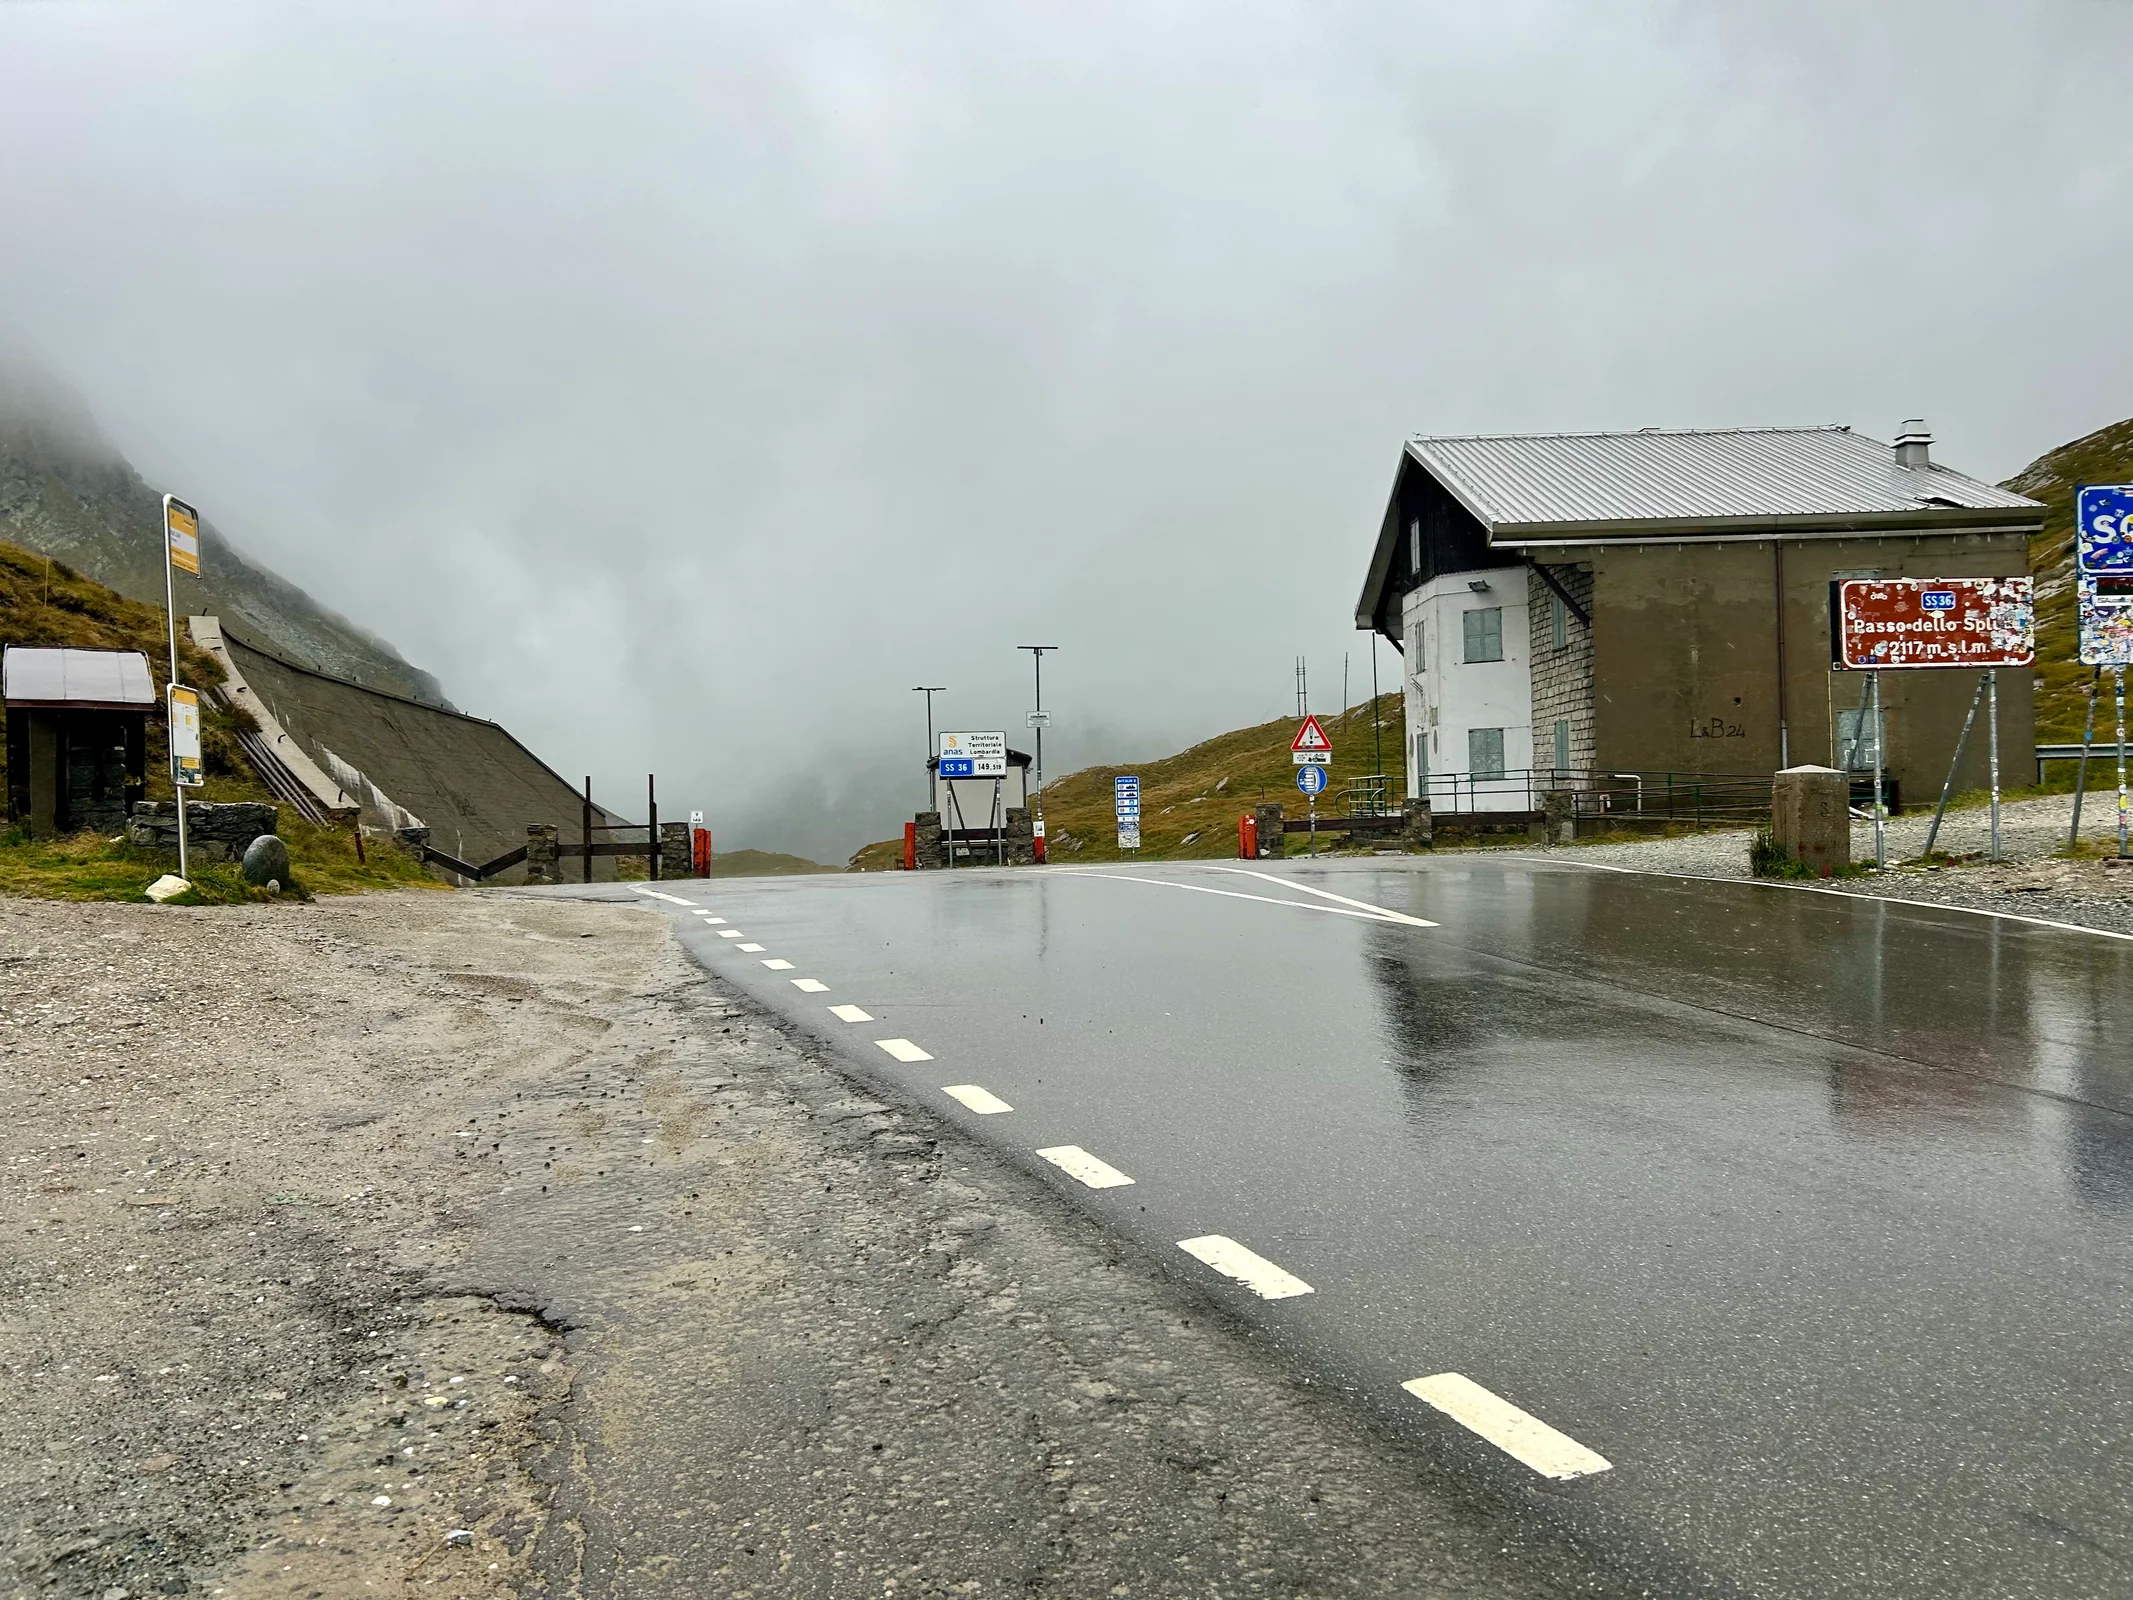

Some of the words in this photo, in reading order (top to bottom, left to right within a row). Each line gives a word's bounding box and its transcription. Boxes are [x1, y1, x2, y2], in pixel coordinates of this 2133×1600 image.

[1925, 595, 1938, 606] SS
[1939, 595, 1952, 606] 36
[1854, 619, 1906, 634] Passo
[1912, 617, 1957, 632] dello
[1889, 641, 1922, 655] 2117
[1927, 643, 1942, 654] m
[1948, 640, 1990, 654] s.l.m.
[945, 763, 955, 772] SS
[957, 763, 968, 772] 36
